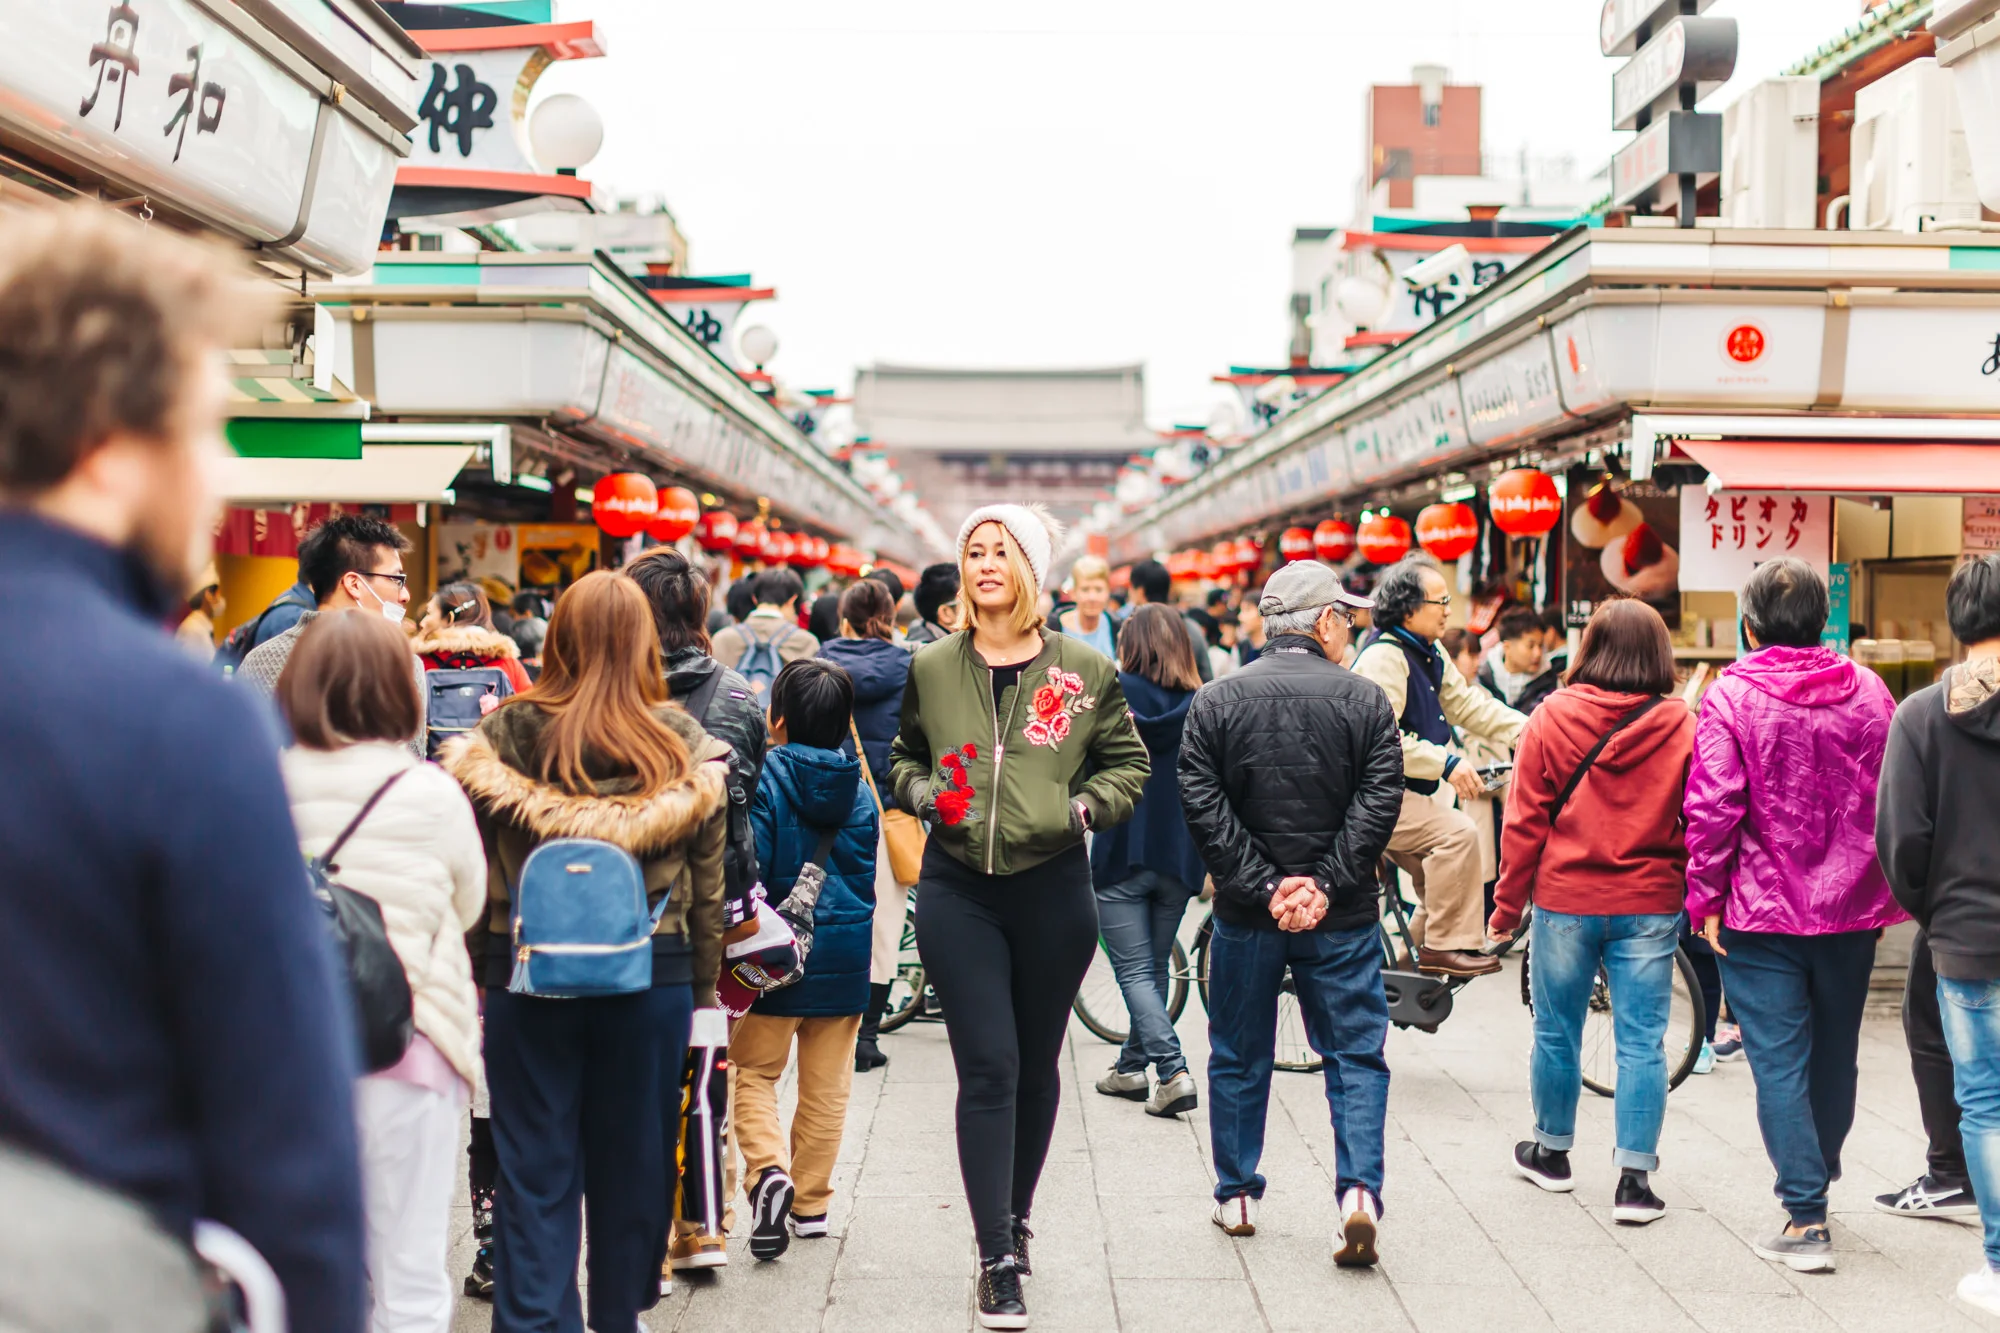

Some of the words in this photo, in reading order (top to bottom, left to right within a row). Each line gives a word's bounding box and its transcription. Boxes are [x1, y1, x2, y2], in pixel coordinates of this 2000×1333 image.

[418, 61, 498, 158] 仲
[1711, 522, 1800, 550] ドリンク
